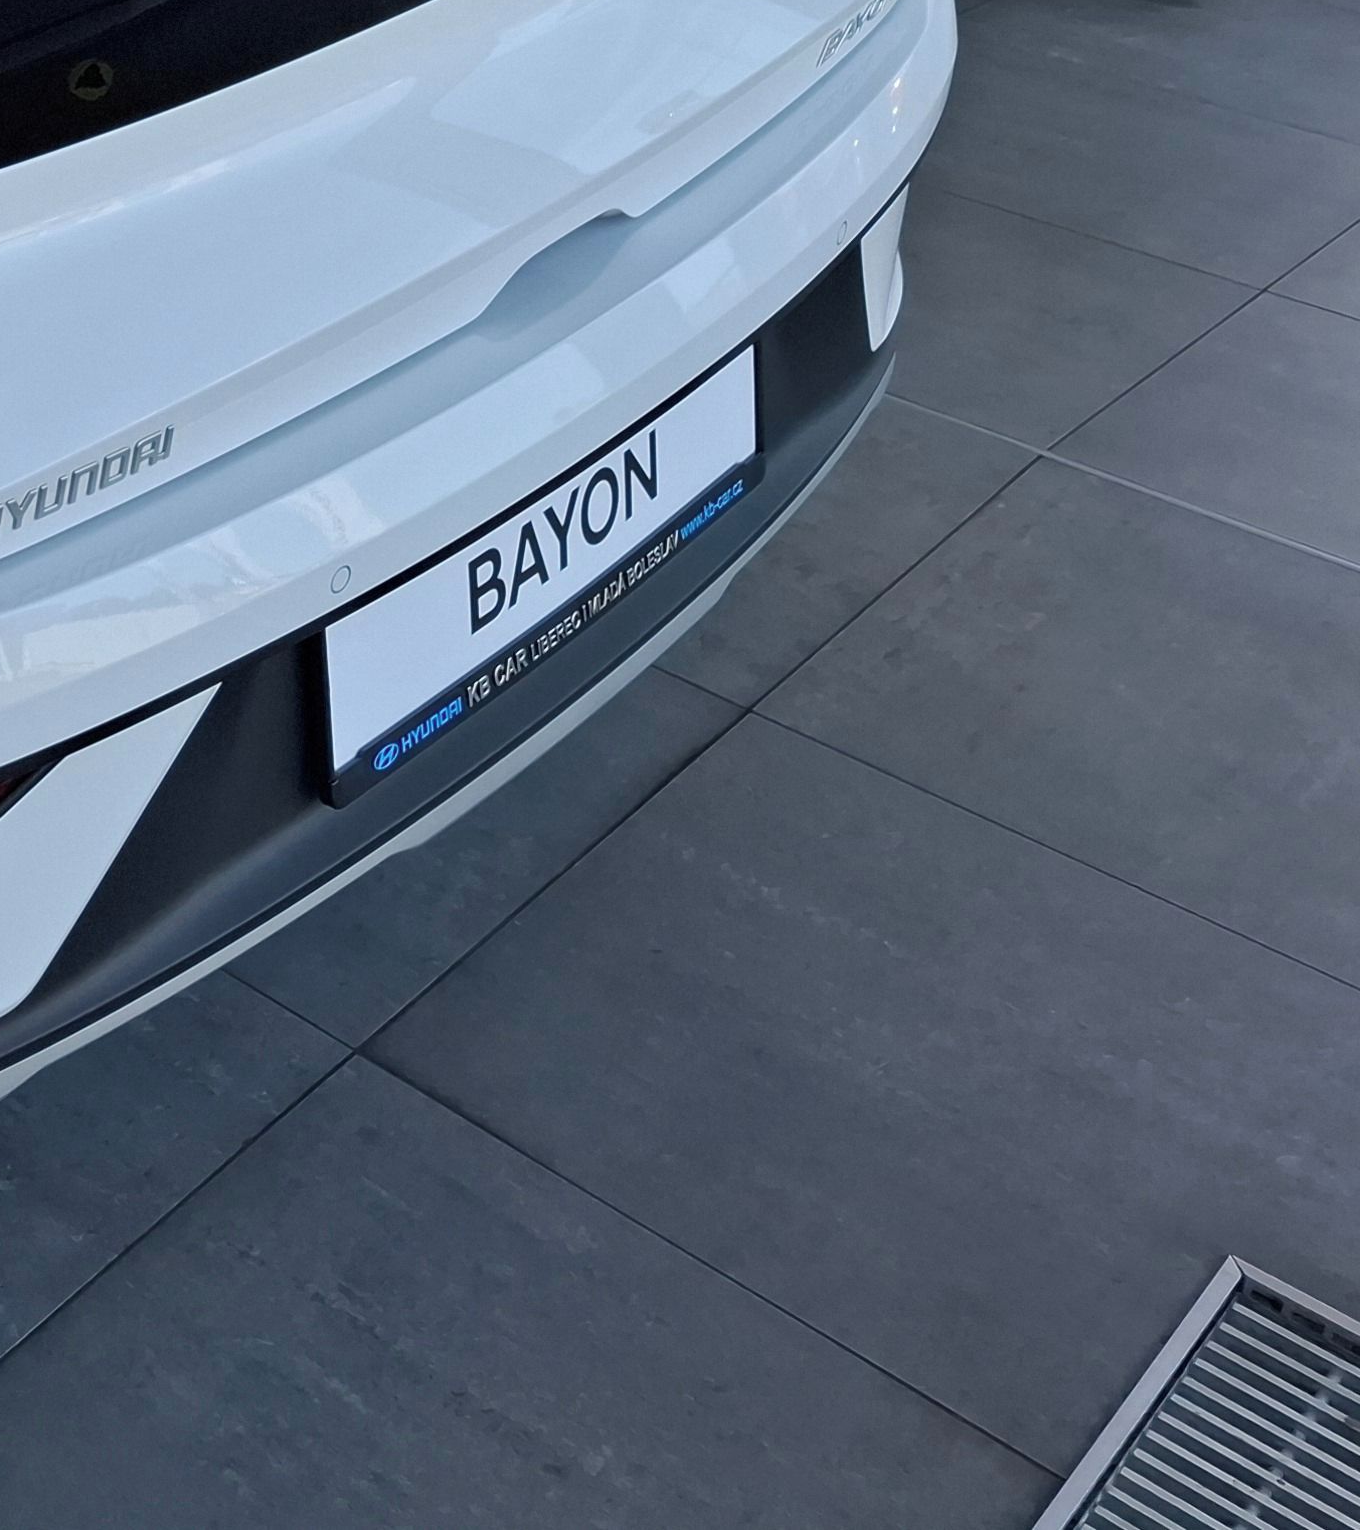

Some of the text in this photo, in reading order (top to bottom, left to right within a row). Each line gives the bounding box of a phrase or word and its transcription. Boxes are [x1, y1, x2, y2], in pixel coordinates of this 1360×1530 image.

[401, 695, 463, 754] HYUNDAI
[466, 674, 492, 708] KB
[493, 647, 529, 687] CAR
[530, 610, 581, 662] LIBEREC
[626, 529, 679, 588] BOLESLAV
[680, 478, 744, 541] www.kb-car.cz
[468, 428, 657, 635] BAYON
